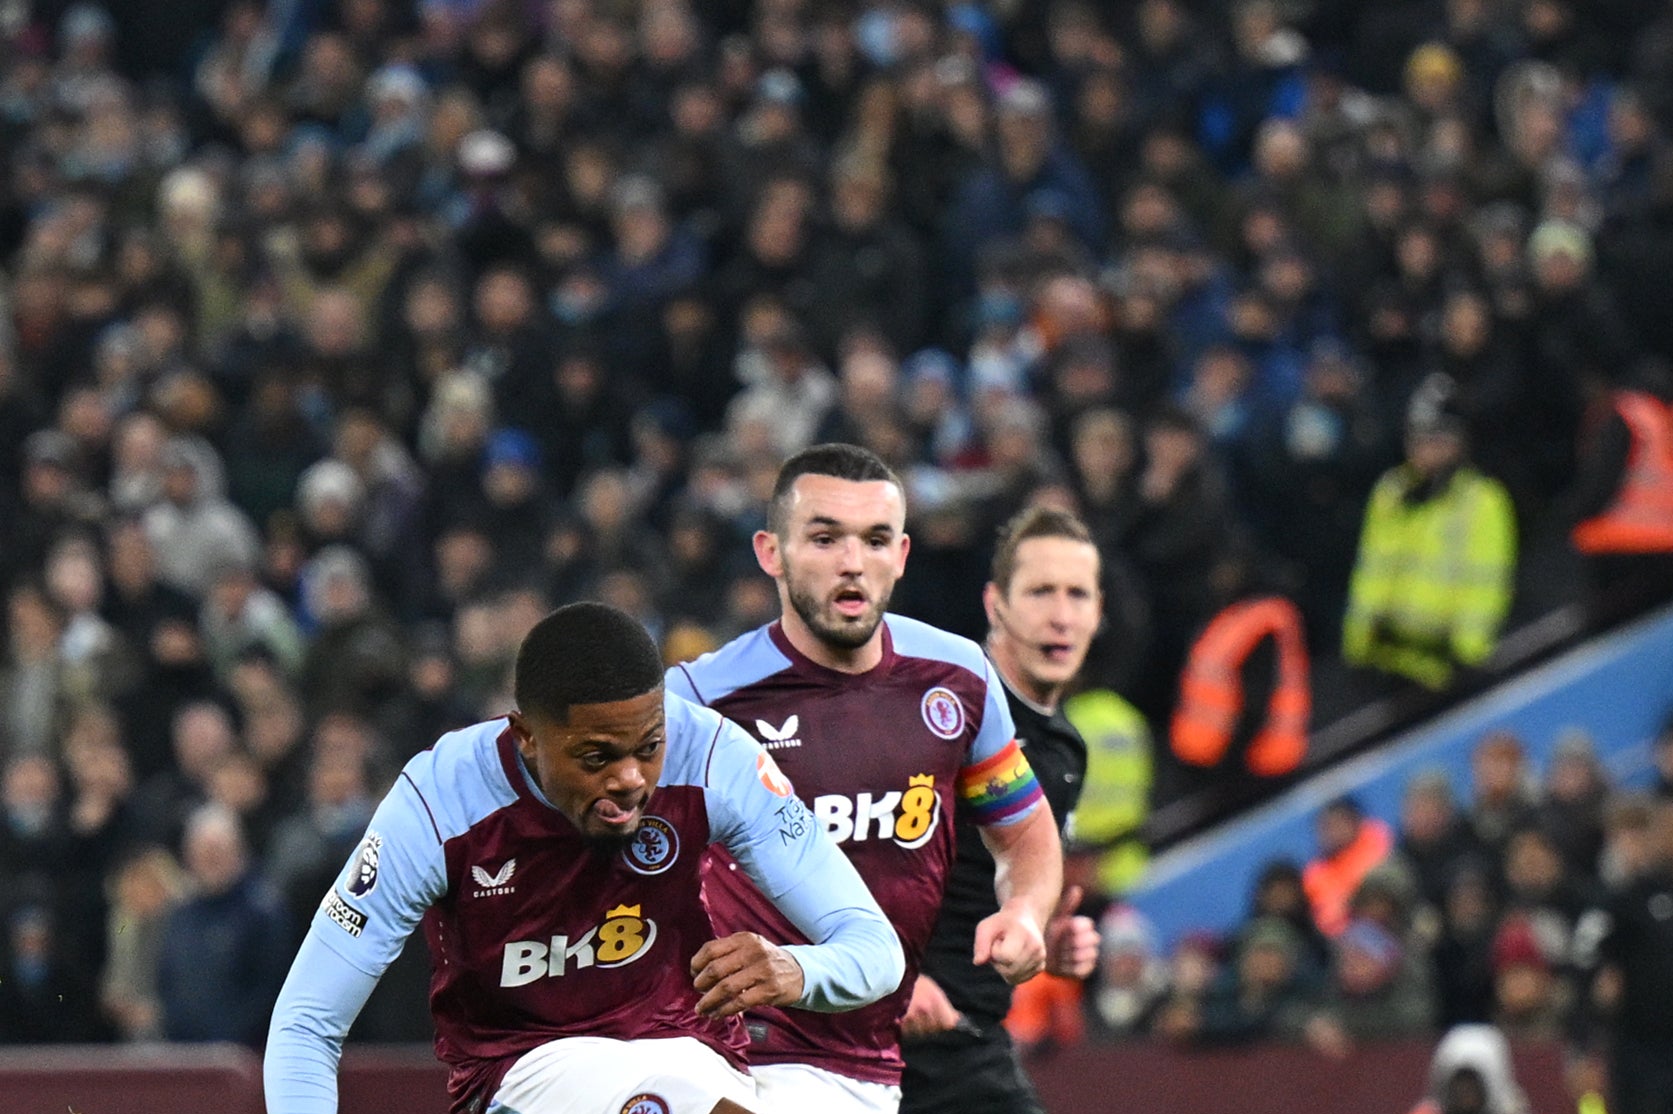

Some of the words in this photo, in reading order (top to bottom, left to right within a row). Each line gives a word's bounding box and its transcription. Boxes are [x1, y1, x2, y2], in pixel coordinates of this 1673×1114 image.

[813, 785, 936, 845] BK8
[473, 886, 516, 898] CASTORE
[499, 916, 646, 988] BK8
